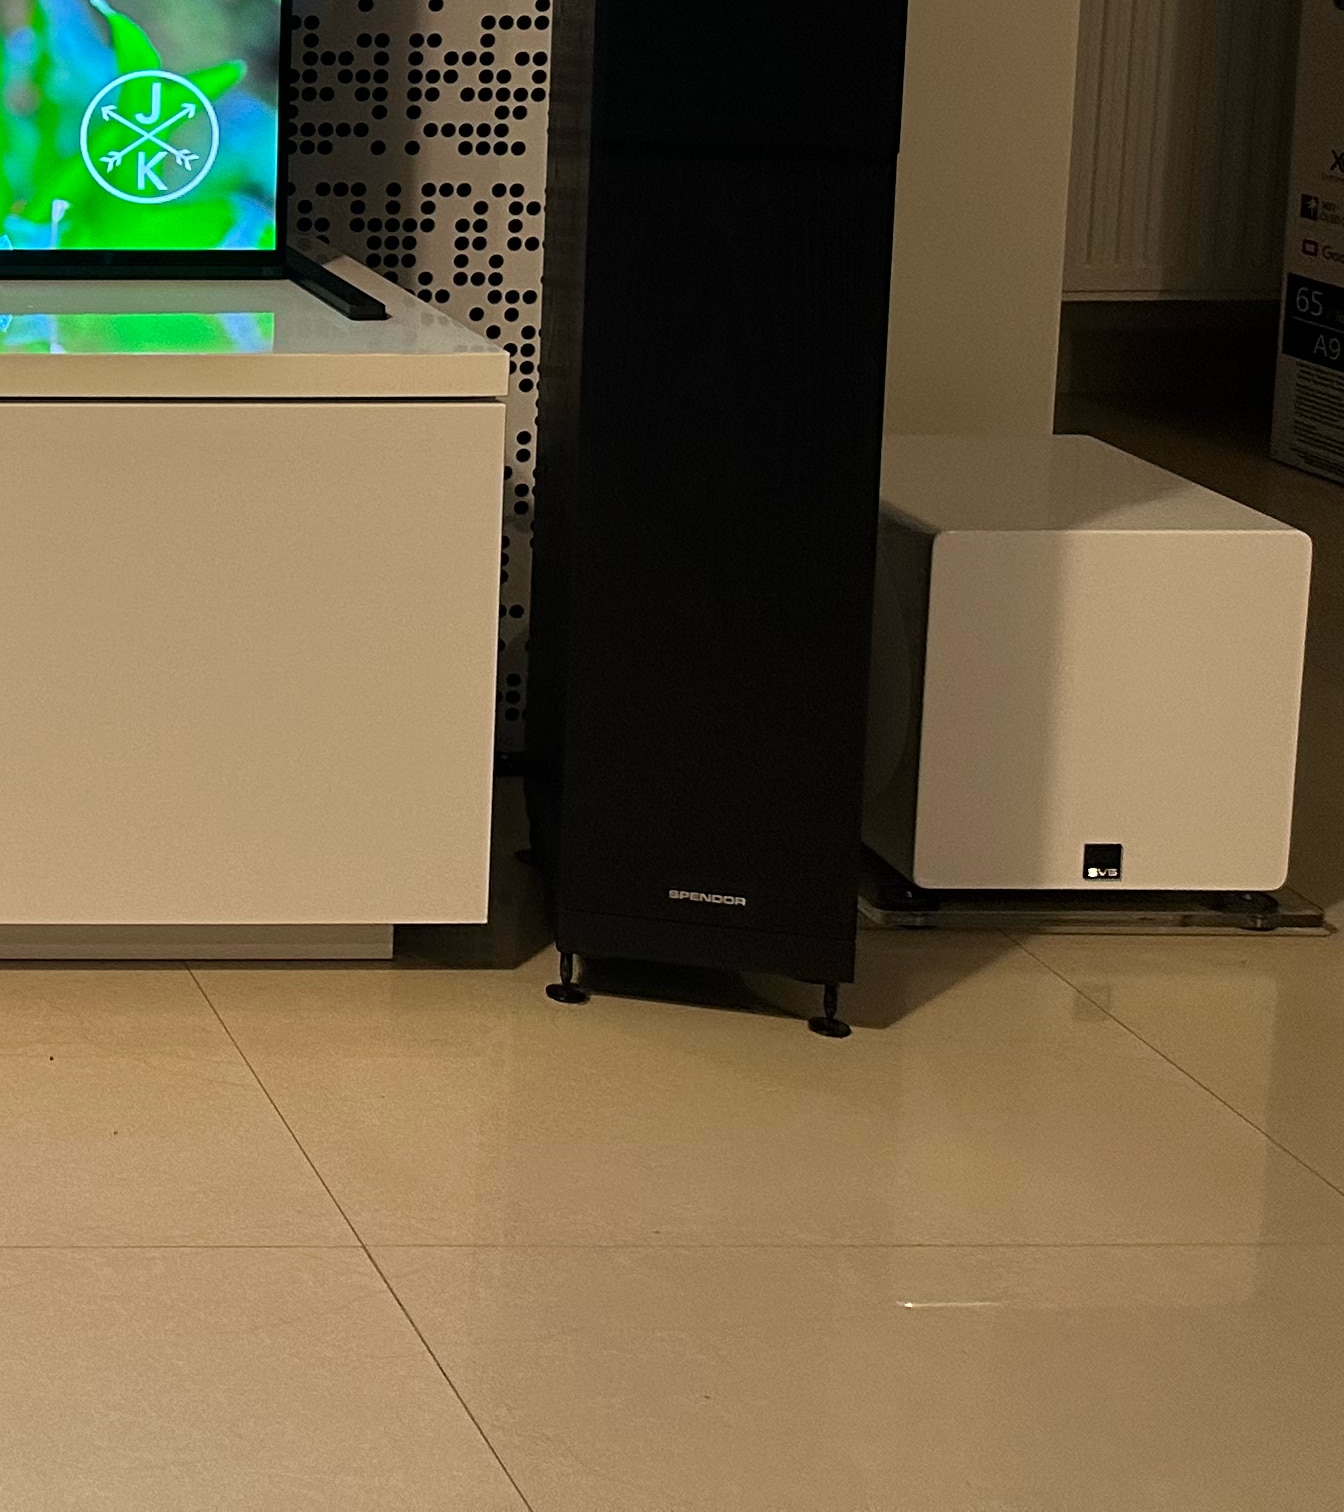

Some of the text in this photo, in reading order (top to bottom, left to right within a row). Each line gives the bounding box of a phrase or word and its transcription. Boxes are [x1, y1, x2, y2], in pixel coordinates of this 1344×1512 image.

[135, 82, 162, 125] J
[137, 151, 168, 191] K
[1295, 286, 1324, 317] 65
[1312, 333, 1341, 361] A9
[668, 889, 747, 907] SPENDOR
